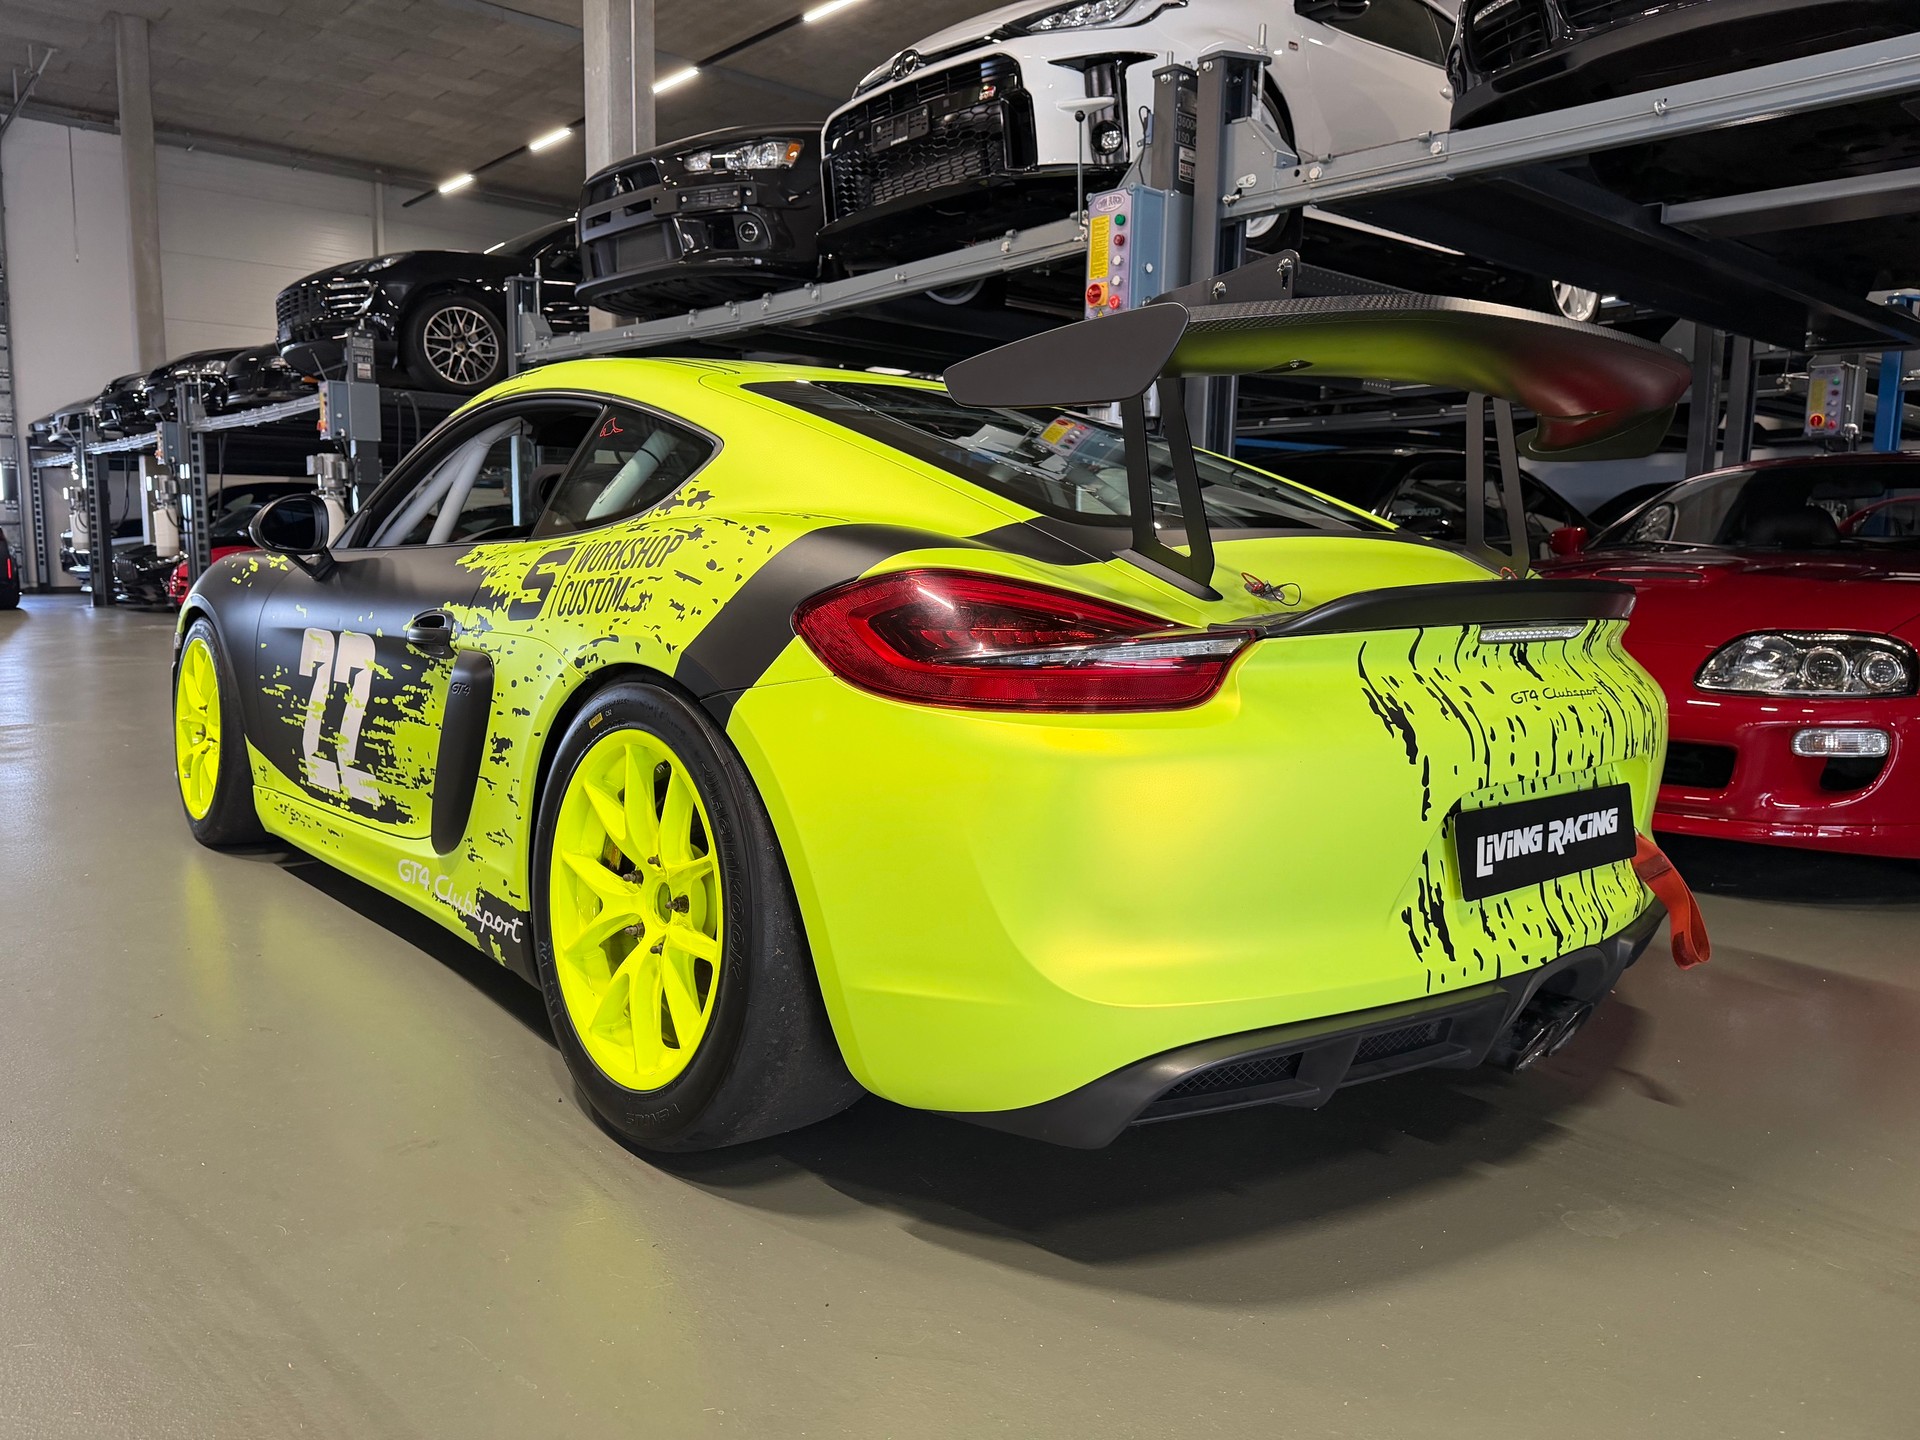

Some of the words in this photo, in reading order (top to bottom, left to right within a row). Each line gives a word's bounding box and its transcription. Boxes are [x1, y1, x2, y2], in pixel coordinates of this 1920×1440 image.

[573, 534, 686, 574] WORKSHOP
[557, 576, 633, 617] CUSTOM
[1510, 689, 1539, 704] GT4
[1542, 686, 1602, 700] Clubsport
[299, 627, 381, 807] 22
[397, 858, 430, 891] GT4
[434, 874, 524, 944] Clubsport
